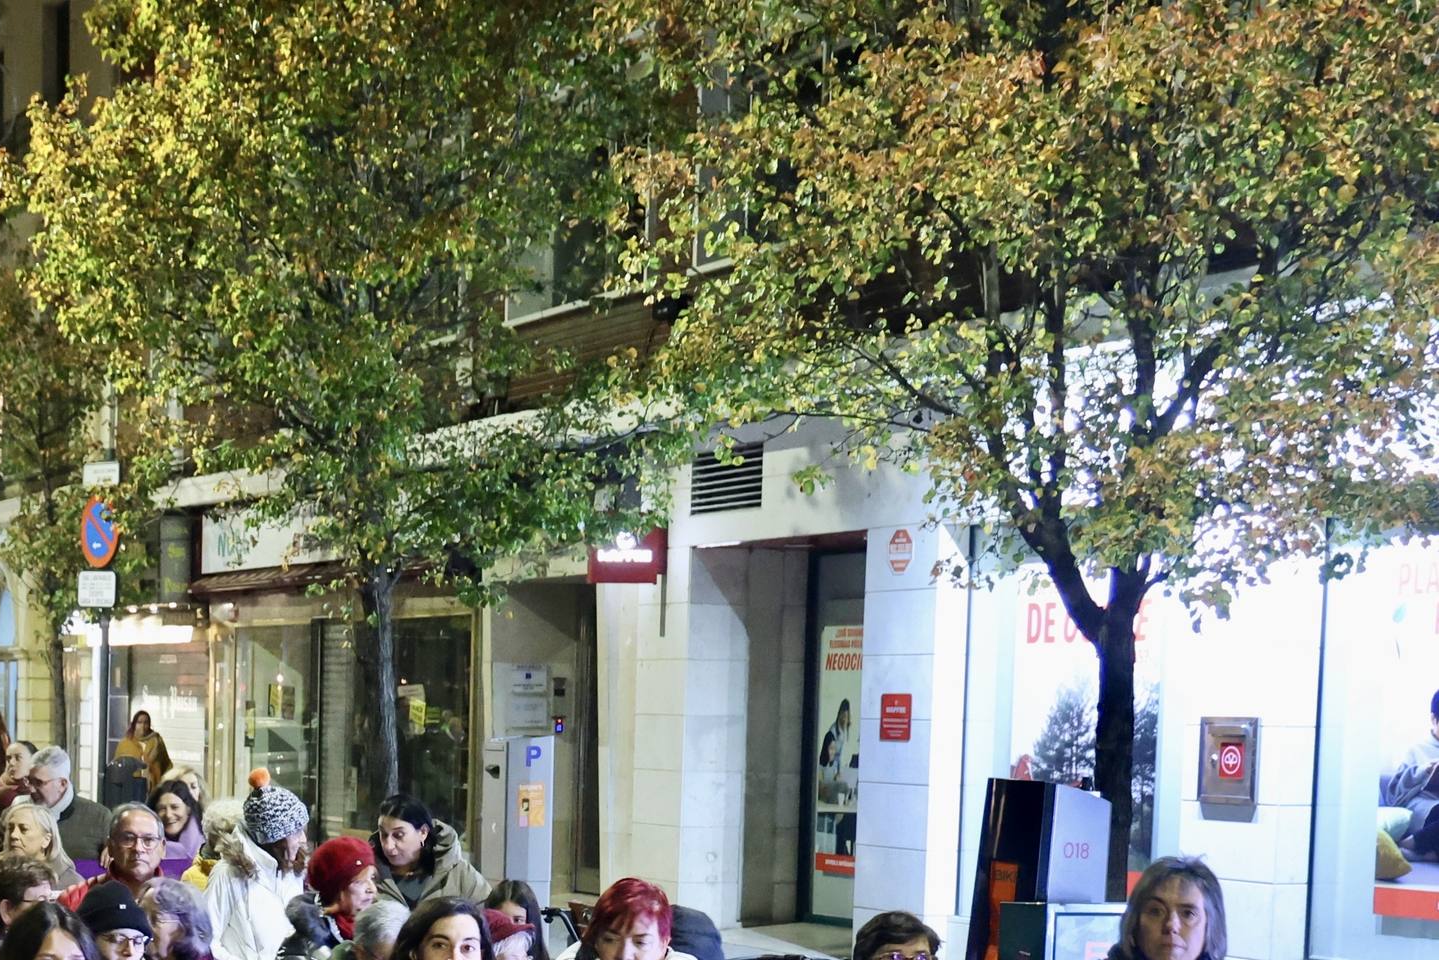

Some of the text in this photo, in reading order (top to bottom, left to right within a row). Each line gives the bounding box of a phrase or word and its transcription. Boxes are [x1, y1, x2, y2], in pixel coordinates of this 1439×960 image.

[1026, 602, 1056, 643] DE
[525, 746, 542, 767] P
[1063, 842, 1090, 859] 018
